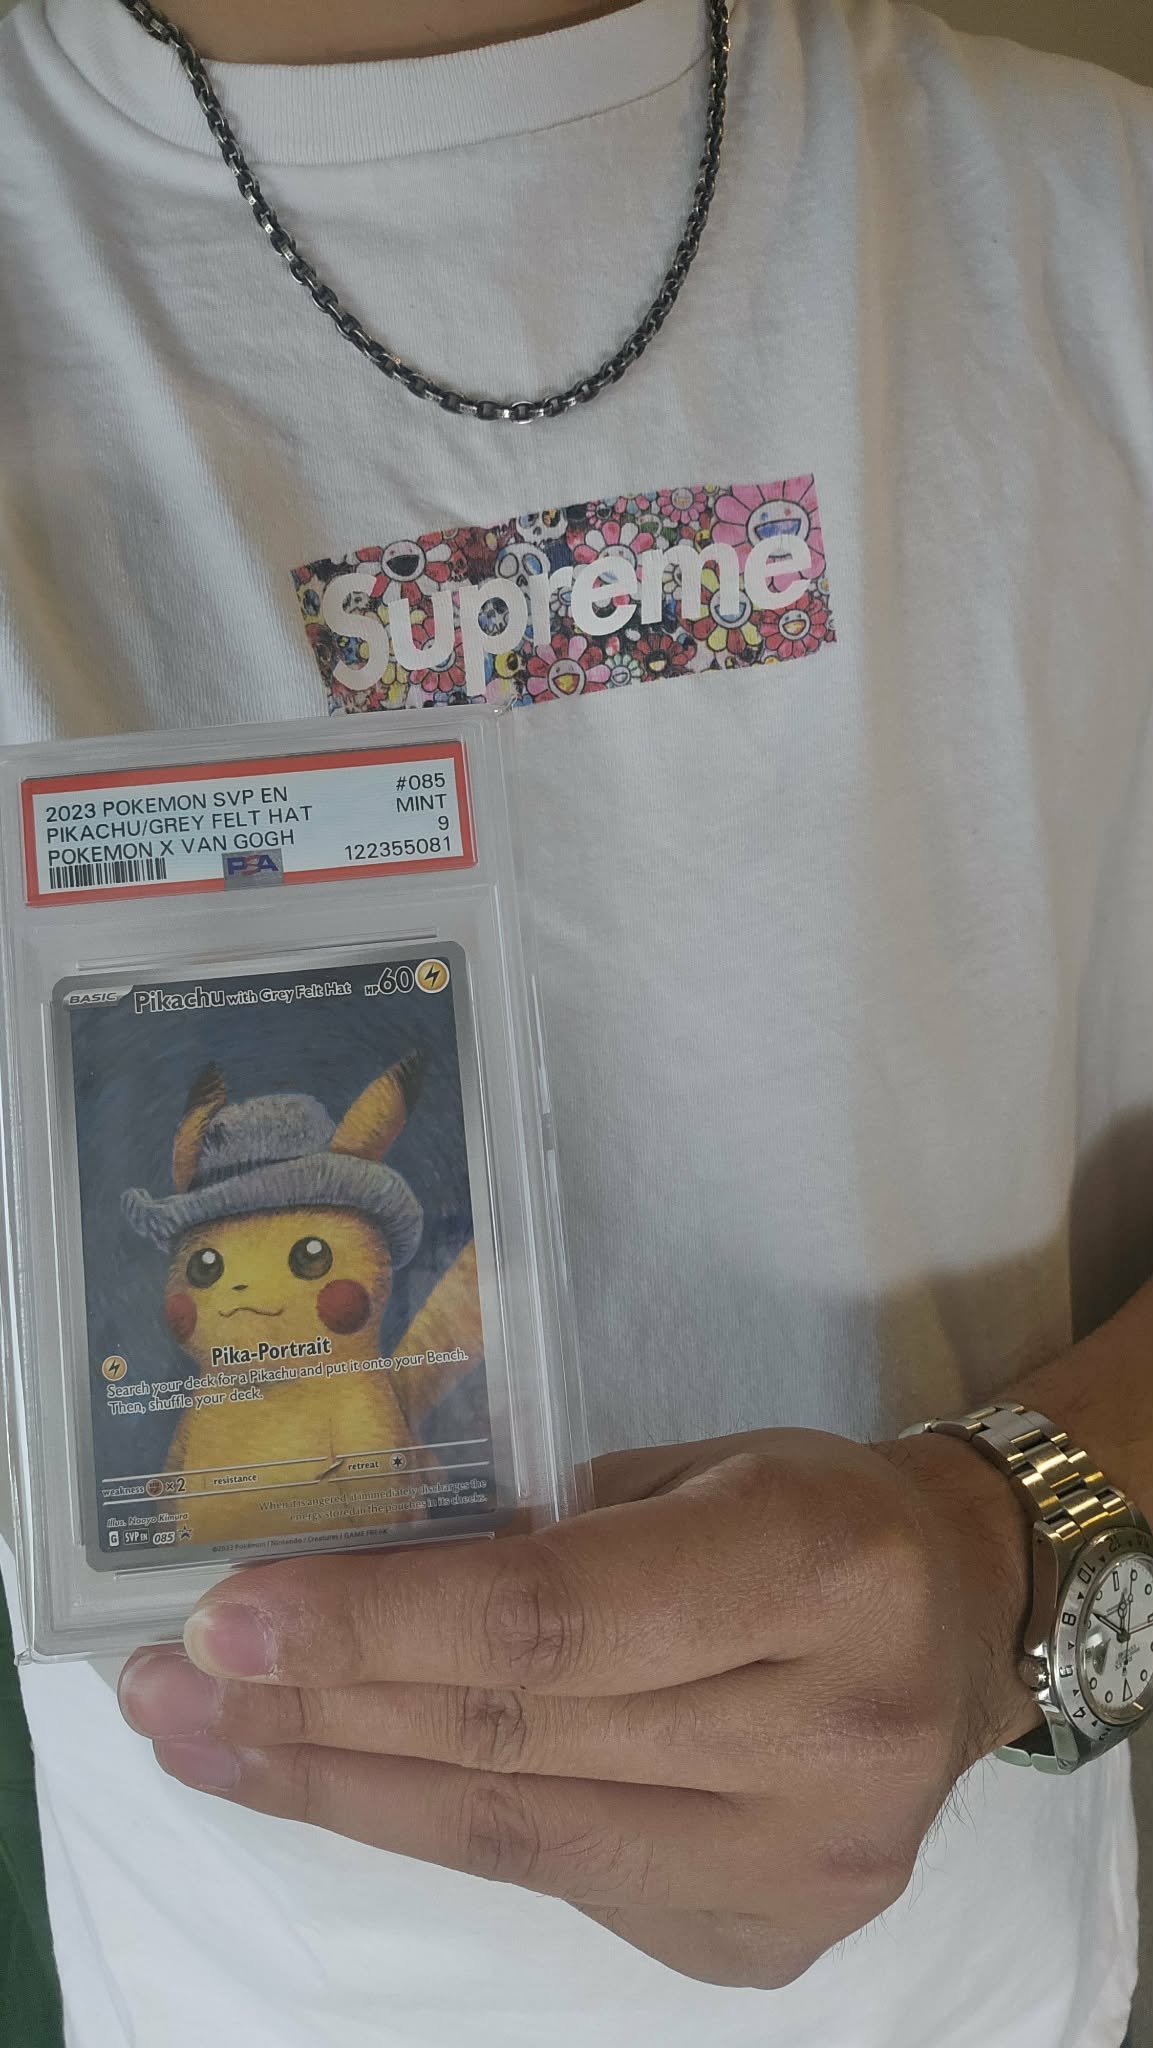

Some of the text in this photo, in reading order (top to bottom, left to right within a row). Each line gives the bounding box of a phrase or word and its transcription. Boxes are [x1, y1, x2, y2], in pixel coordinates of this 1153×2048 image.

[321, 534, 812, 699] Supreme
[395, 772, 446, 792] #085
[45, 786, 288, 823] 2023 POKEMON SVP EN
[395, 794, 448, 814] MINT
[47, 804, 313, 844] PIKACHU/GREY FELT HAT
[437, 815, 450, 832] 9
[48, 829, 295, 867] POKEMON X VAN GOGH
[343, 836, 452, 862] 122355081
[227, 853, 279, 877] PSA
[378, 966, 415, 995] 60
[68, 991, 117, 1006] BASIC
[134, 980, 352, 1014] Pikachu with Grey Felt Hat
[210, 1336, 332, 1367] Pika-Portrait
[106, 1347, 469, 1401] Search your deck for a Pikachu and put it onto your Bench.
[107, 1386, 263, 1417] Then, shuffle your deck.
[347, 1460, 380, 1471] retreat
[102, 1486, 144, 1498] weakness
[213, 1474, 257, 1486] resistance
[158, 1512, 190, 1523] Kimura
[124, 1530, 140, 1543] SVP
[153, 1531, 175, 1545] 085
[1077, 1561, 1097, 1585] 10
[1061, 1611, 1077, 1627] 8
[1072, 1706, 1087, 1718] 4
